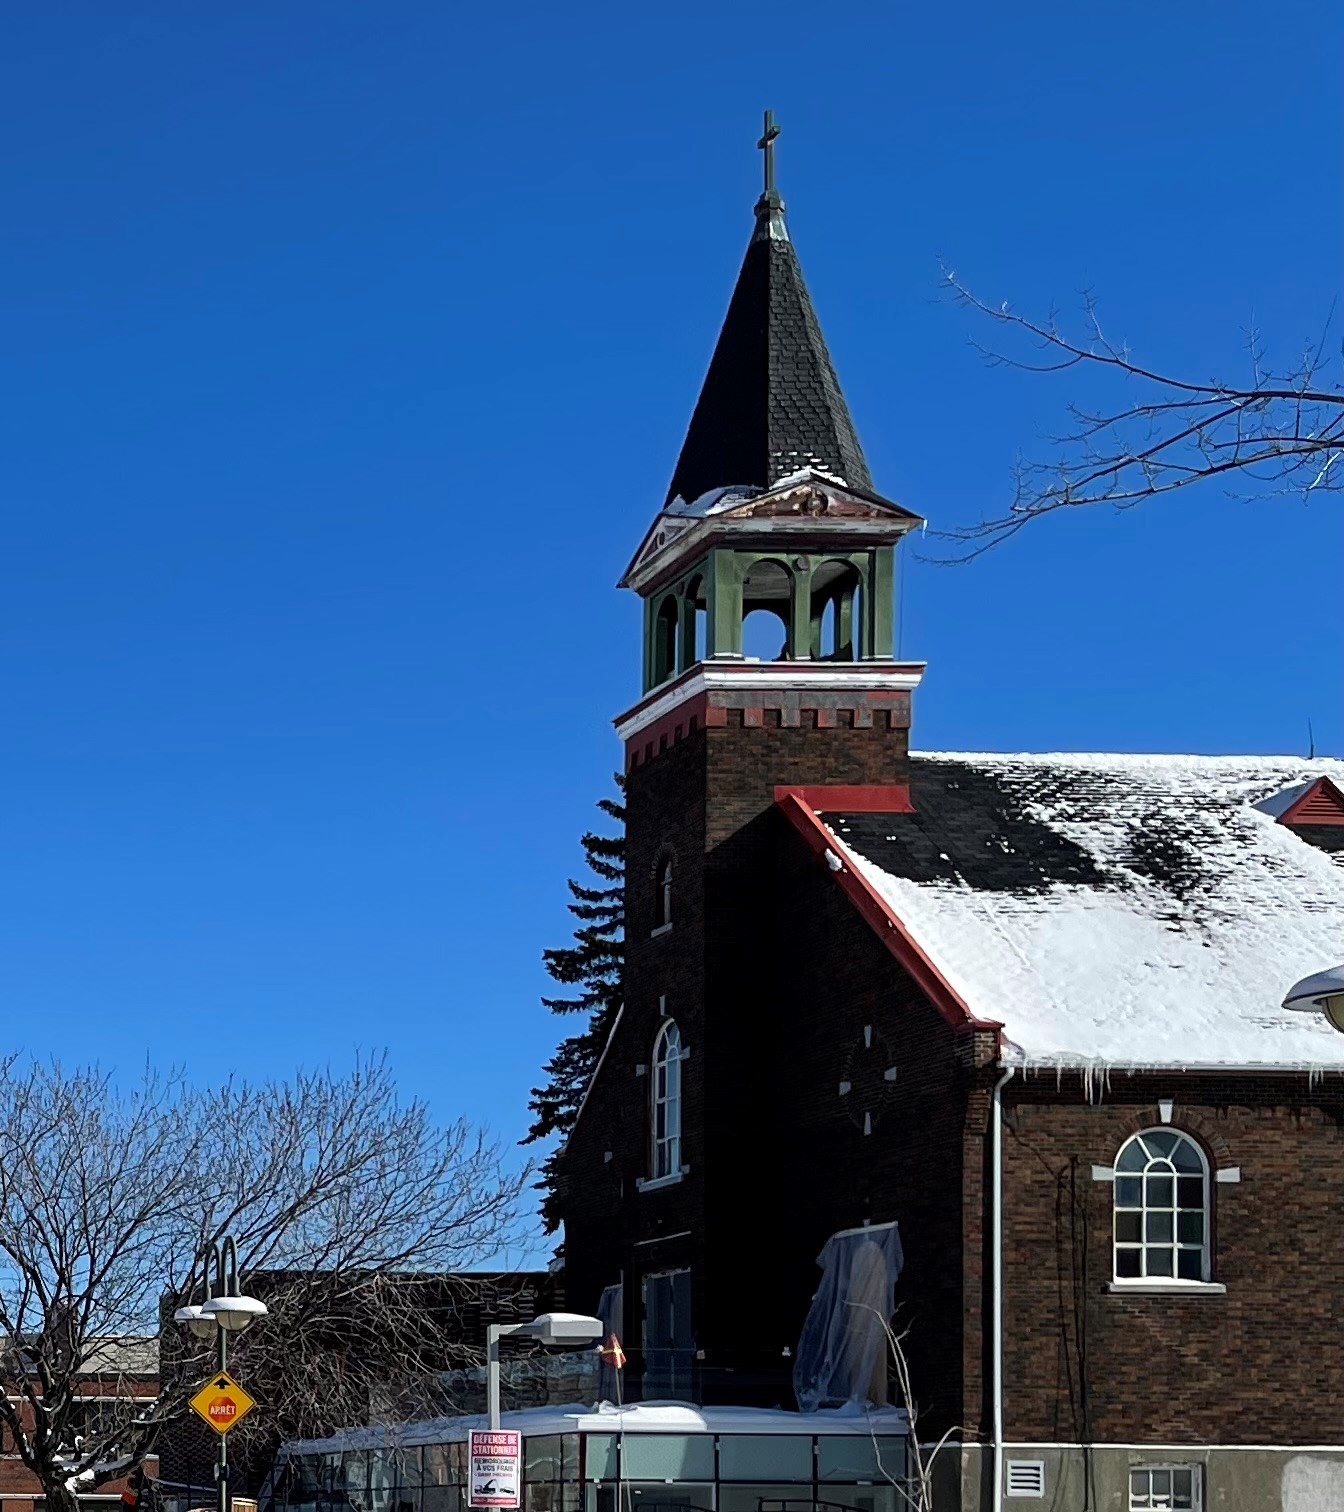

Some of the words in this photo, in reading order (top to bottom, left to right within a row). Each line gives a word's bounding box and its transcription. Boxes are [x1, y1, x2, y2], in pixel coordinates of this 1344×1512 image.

[210, 1405, 236, 1415] ARRÊT
[474, 1434, 507, 1445] DÉFENSE
[508, 1435, 517, 1445] DE
